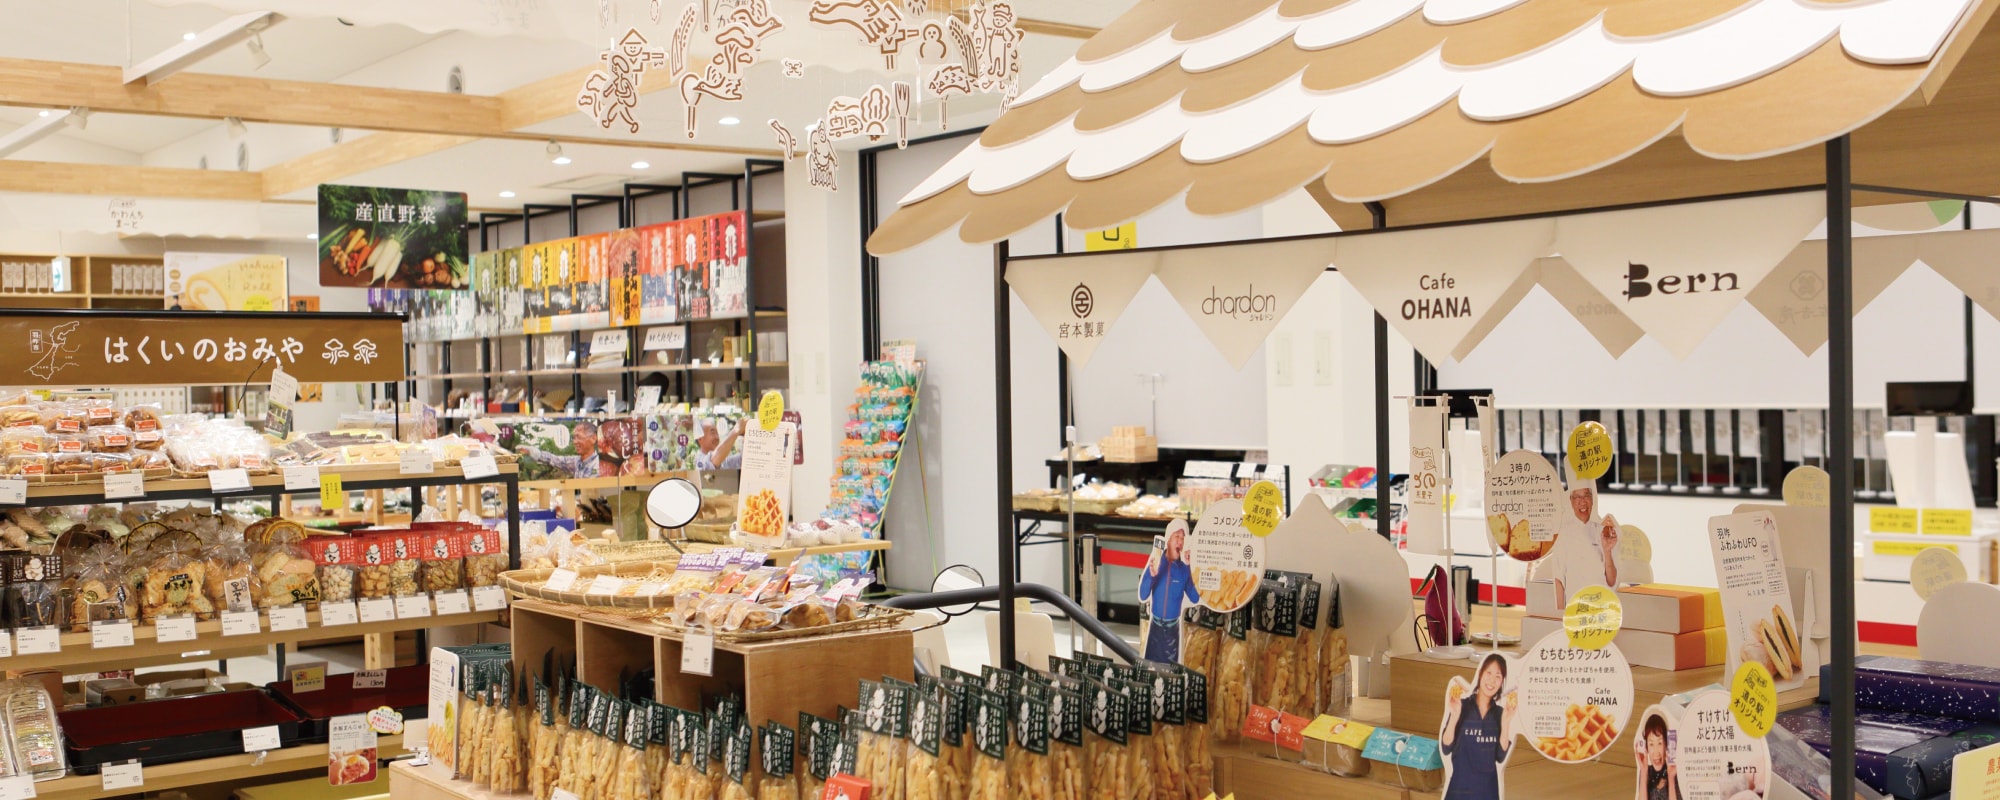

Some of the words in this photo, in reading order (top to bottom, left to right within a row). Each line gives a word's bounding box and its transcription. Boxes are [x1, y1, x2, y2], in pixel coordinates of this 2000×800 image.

[355, 201, 436, 225] 産直野菜
[1420, 272, 1455, 291] Cafe
[1622, 260, 1741, 303] Bern
[1201, 283, 1276, 320] chardon
[1401, 296, 1472, 320] OHANA
[1058, 322, 1105, 338] 宮本製菓
[104, 335, 304, 364] はくいのおみや
[1579, 445, 1602, 460] 道の駅
[1510, 462, 1531, 473] 3時の
[1577, 455, 1608, 472] オリジナル
[1252, 504, 1273, 519] 道の駅
[1245, 514, 1273, 528] オリジナル
[1720, 537, 1757, 551] ふわふわUFO
[1540, 648, 1612, 661] むちむちワッフル
[1586, 696, 1618, 706] OHANA
[1741, 690, 1765, 717] 道の駅
[1697, 708, 1730, 724] すけすけ
[1734, 698, 1764, 730] オリジナル
[1696, 725, 1735, 740] ぶどう大福
[1727, 761, 1758, 775] Bern
